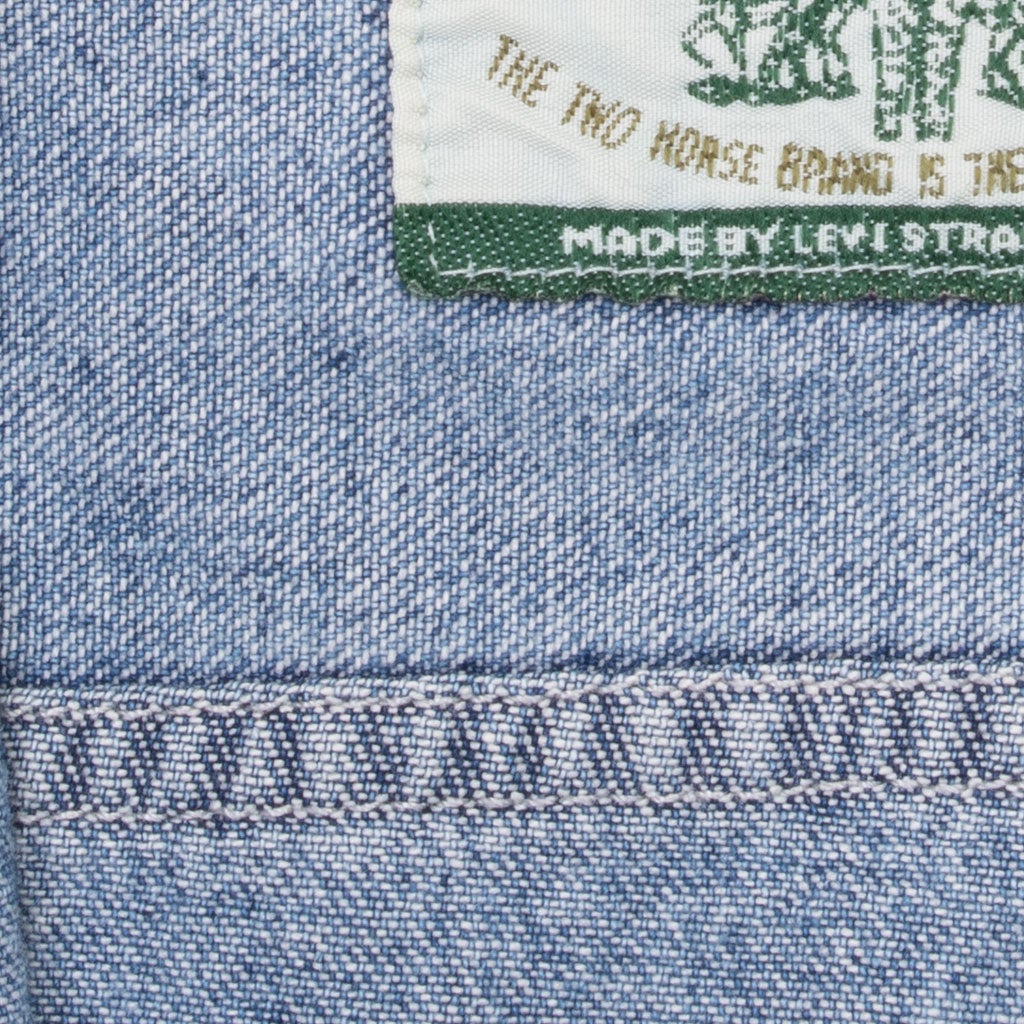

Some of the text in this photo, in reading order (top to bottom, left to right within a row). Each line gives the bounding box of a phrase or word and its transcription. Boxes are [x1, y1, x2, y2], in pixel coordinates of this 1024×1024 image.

[488, 34, 559, 107] THE
[561, 81, 642, 150] TWO
[649, 120, 765, 185] HORSE
[776, 142, 893, 197] BRAND
[919, 152, 945, 200] IS
[559, 222, 705, 256] MADE
[716, 223, 783, 255] BY
[792, 222, 888, 253] LEVI
